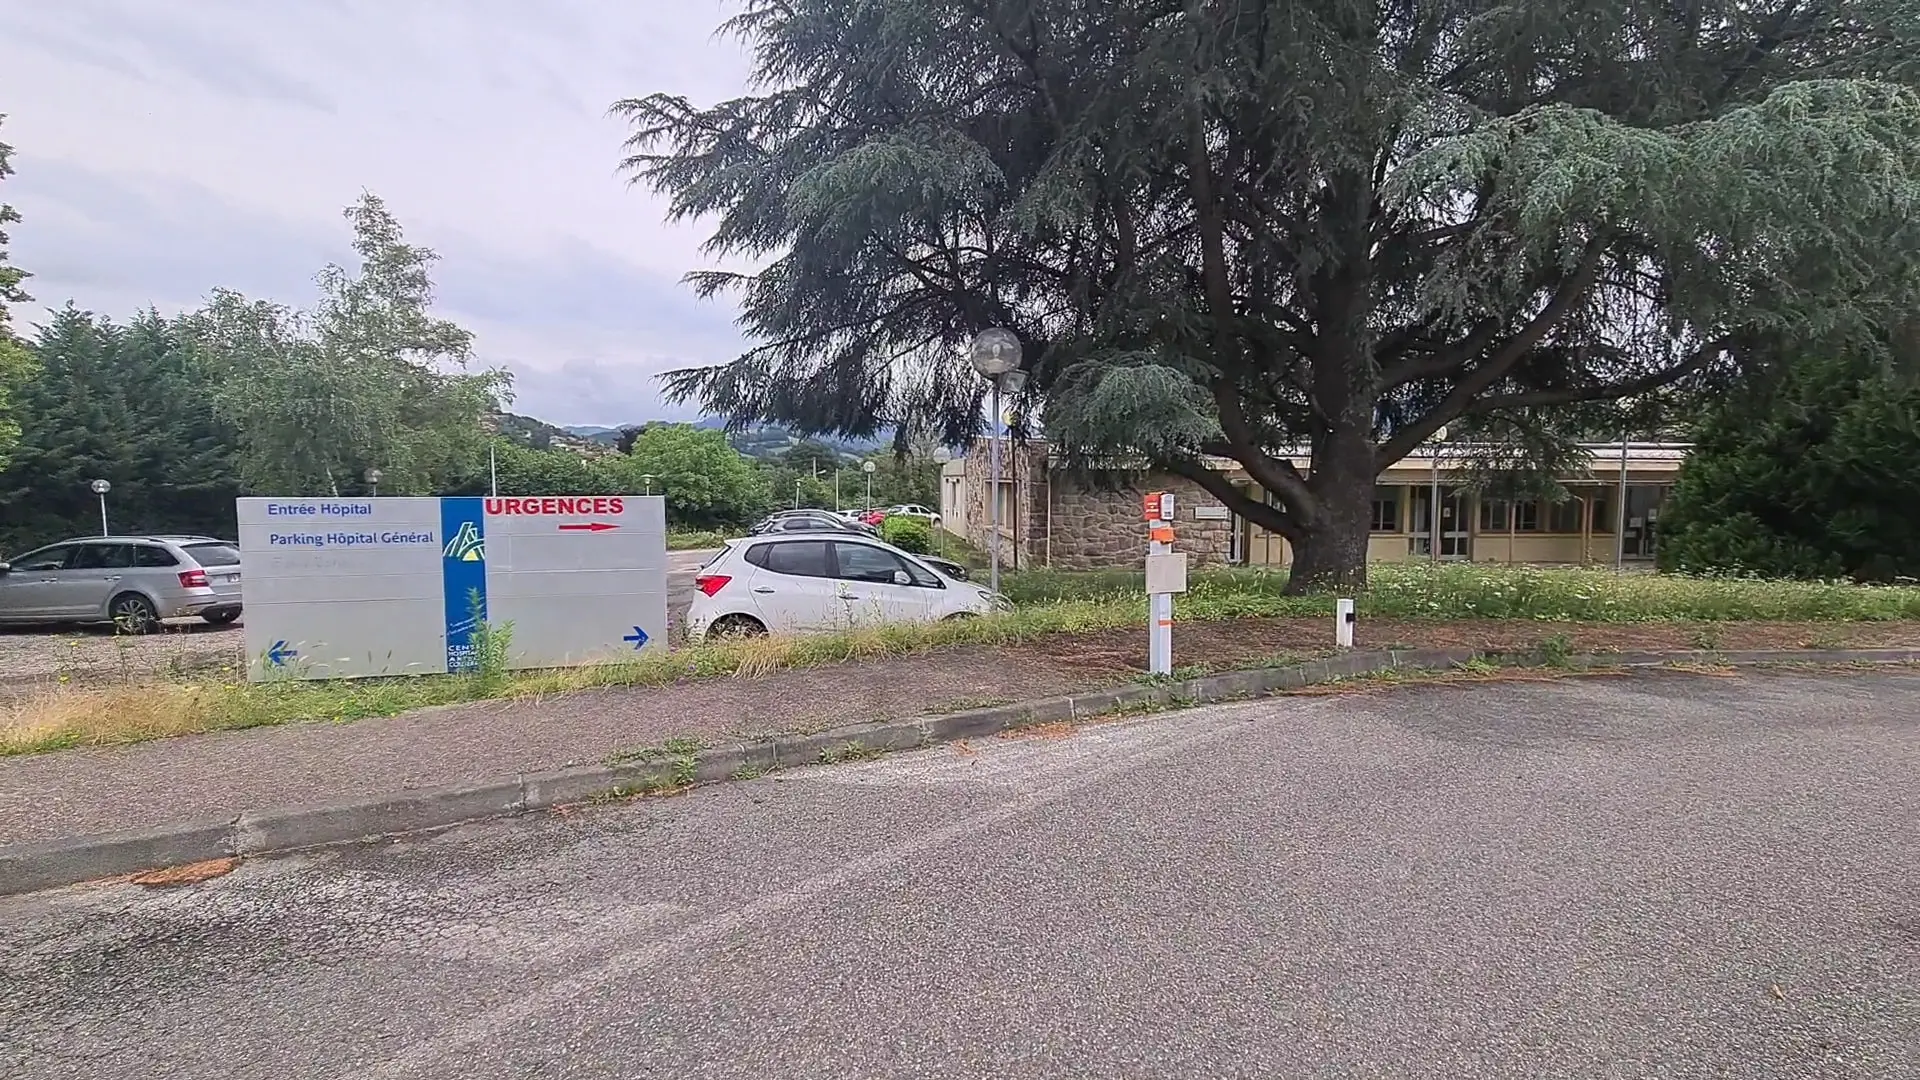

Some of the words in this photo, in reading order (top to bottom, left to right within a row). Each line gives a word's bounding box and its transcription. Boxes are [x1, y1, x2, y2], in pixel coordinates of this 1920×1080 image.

[268, 503, 316, 515] Entrée
[321, 503, 372, 517] Hôpital
[485, 498, 623, 515] URGENCES
[270, 533, 324, 547] Parking
[327, 532, 377, 546] Hôpital
[381, 531, 434, 543] Général
